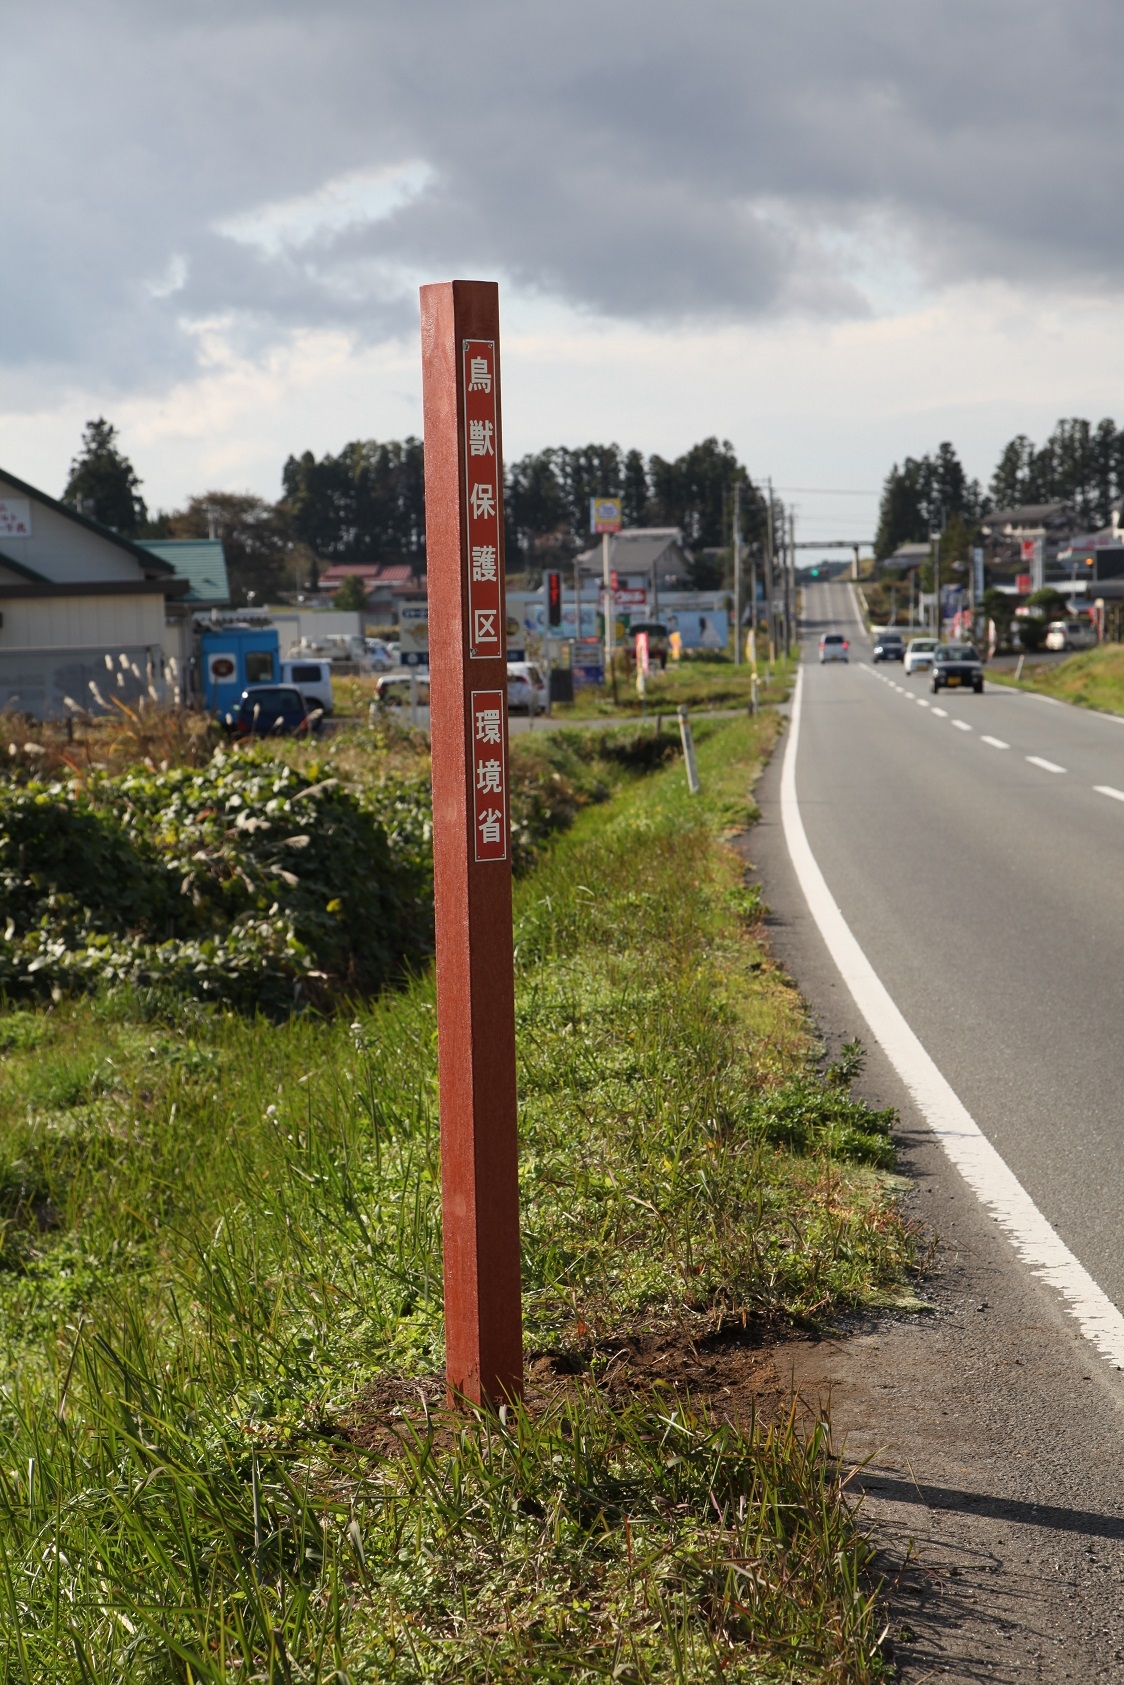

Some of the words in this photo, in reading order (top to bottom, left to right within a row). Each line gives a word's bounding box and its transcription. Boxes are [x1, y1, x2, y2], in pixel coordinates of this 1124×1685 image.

[467, 356, 498, 644] 鳥獣保護区
[475, 709, 502, 844] 環境省
